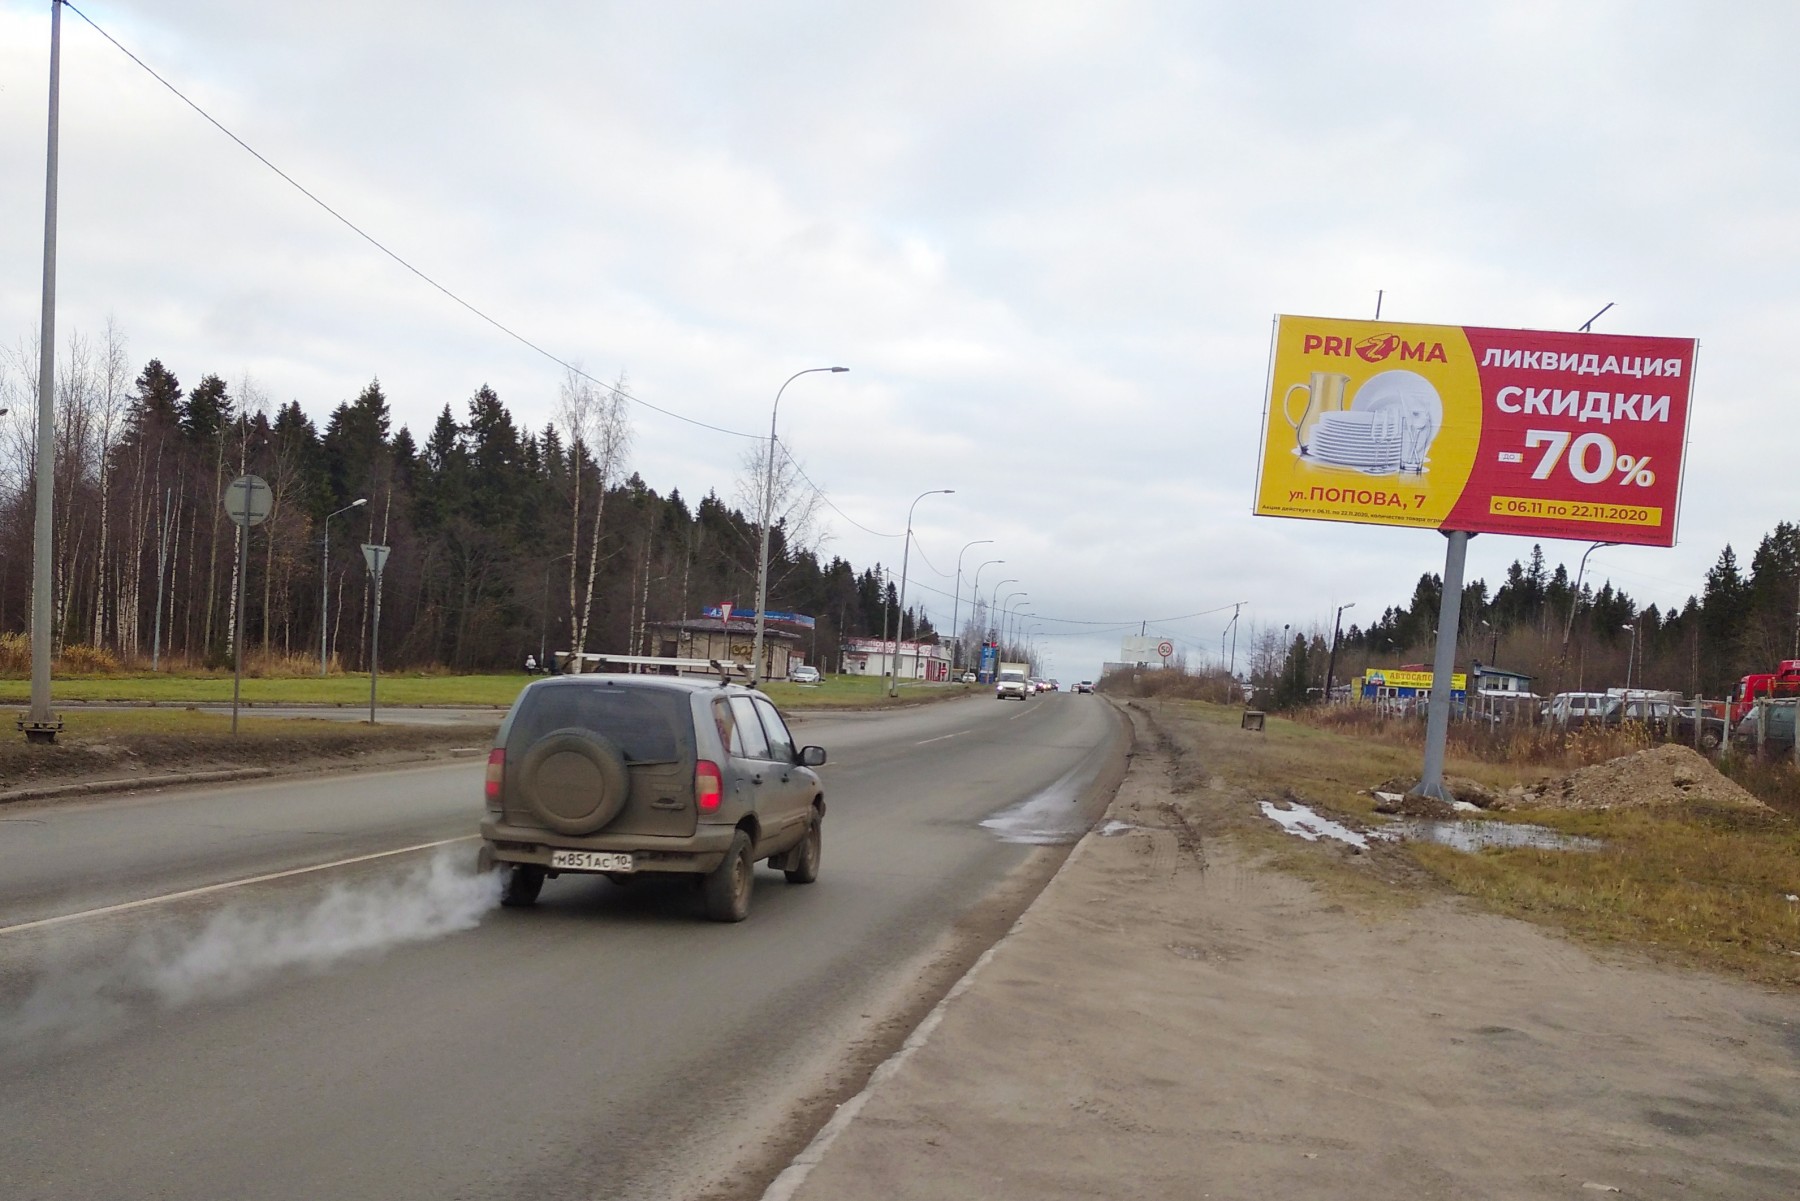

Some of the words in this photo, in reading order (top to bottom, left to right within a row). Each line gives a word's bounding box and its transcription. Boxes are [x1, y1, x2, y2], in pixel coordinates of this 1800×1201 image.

[1481, 348, 1682, 379] ЛИКВИДАЦИЯ
[1496, 385, 1671, 424] СКИДКИ
[1289, 490, 1308, 502] ул.
[1310, 487, 1407, 510] ПОПОВА,
[1413, 494, 1427, 509] 7
[1506, 501, 1543, 514] 06.11
[1547, 505, 1568, 517] по
[1571, 504, 1649, 522] 22.11.2020
[557, 853, 610, 868] М851АС
[614, 855, 628, 865] 10
